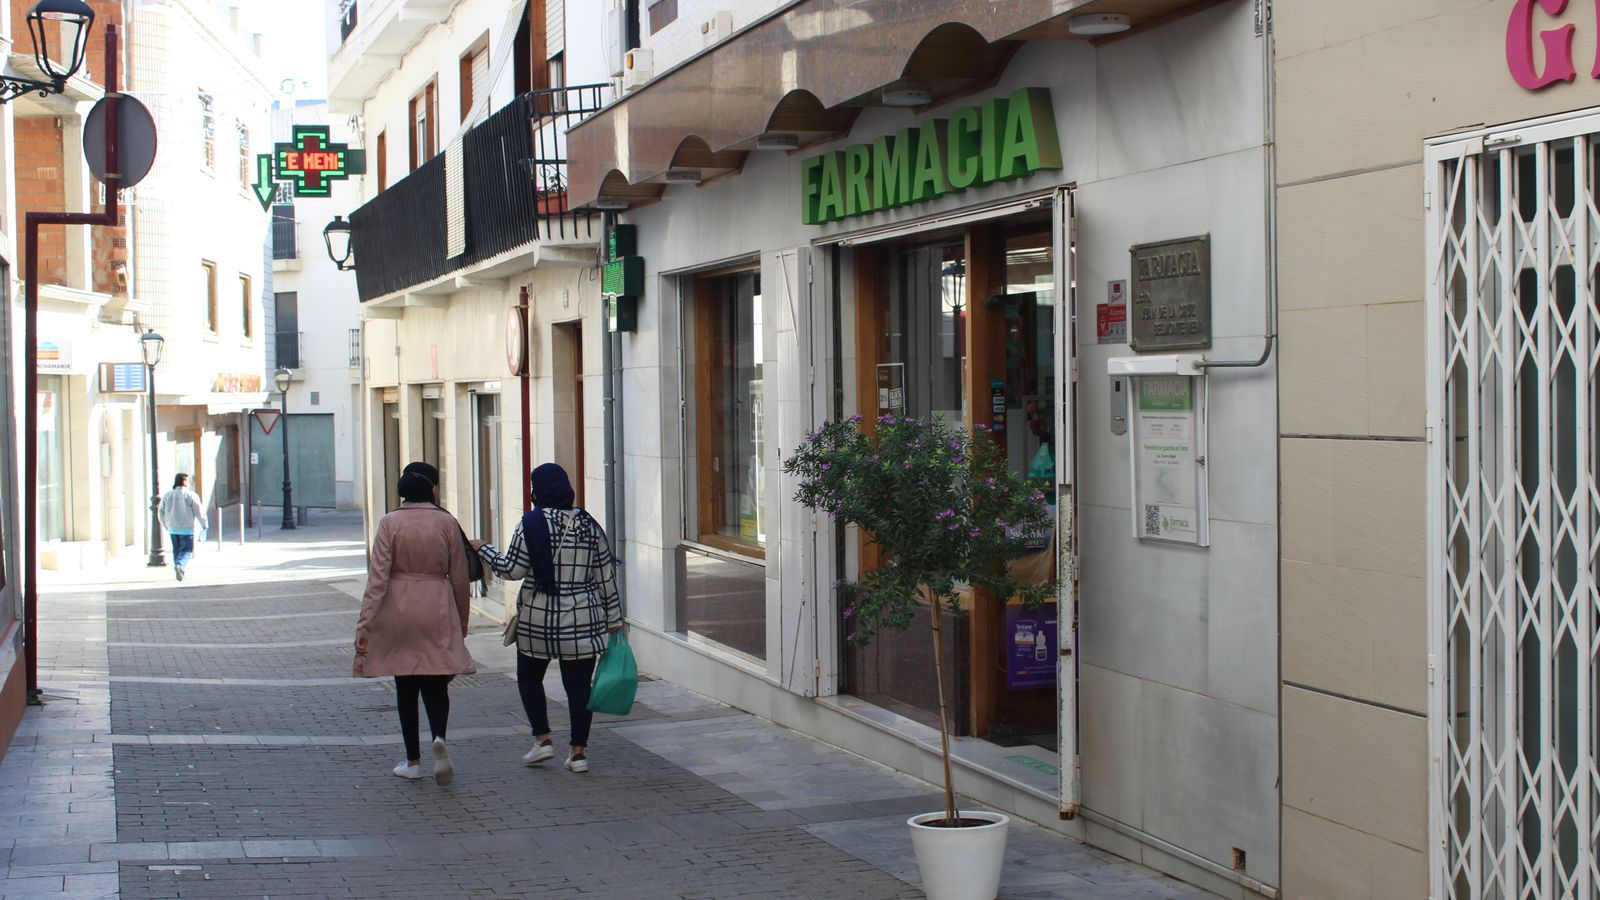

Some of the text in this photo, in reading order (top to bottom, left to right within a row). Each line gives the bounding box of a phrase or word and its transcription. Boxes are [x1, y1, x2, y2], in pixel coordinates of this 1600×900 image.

[1505, 0, 1600, 90] G
[802, 87, 1062, 225] FARMACIA
[1138, 252, 1201, 281] FARMACIA
[1143, 381, 1189, 397] FARMACIA
